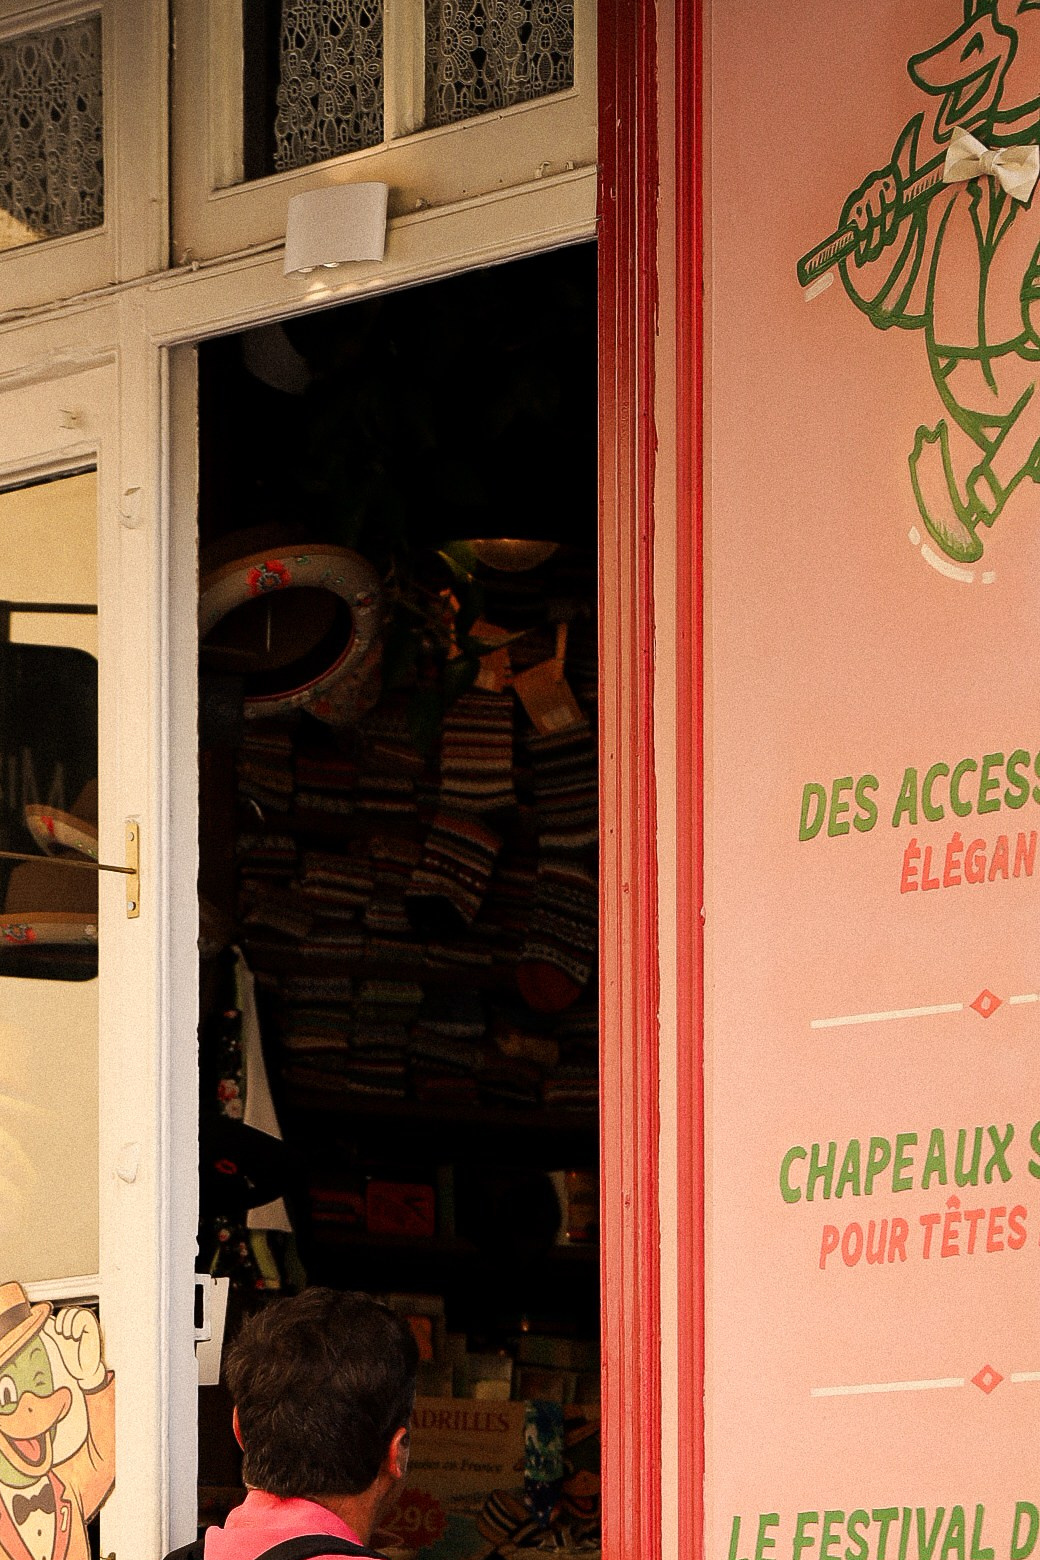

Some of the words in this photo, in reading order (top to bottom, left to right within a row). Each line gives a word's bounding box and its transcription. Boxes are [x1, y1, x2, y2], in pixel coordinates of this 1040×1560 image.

[798, 774, 879, 842] DES
[892, 749, 1040, 828] ACCES
[779, 1123, 1015, 1203] CHAPEAUX
[819, 1216, 909, 1270] POUR
[919, 1194, 1028, 1259] TÊTES
